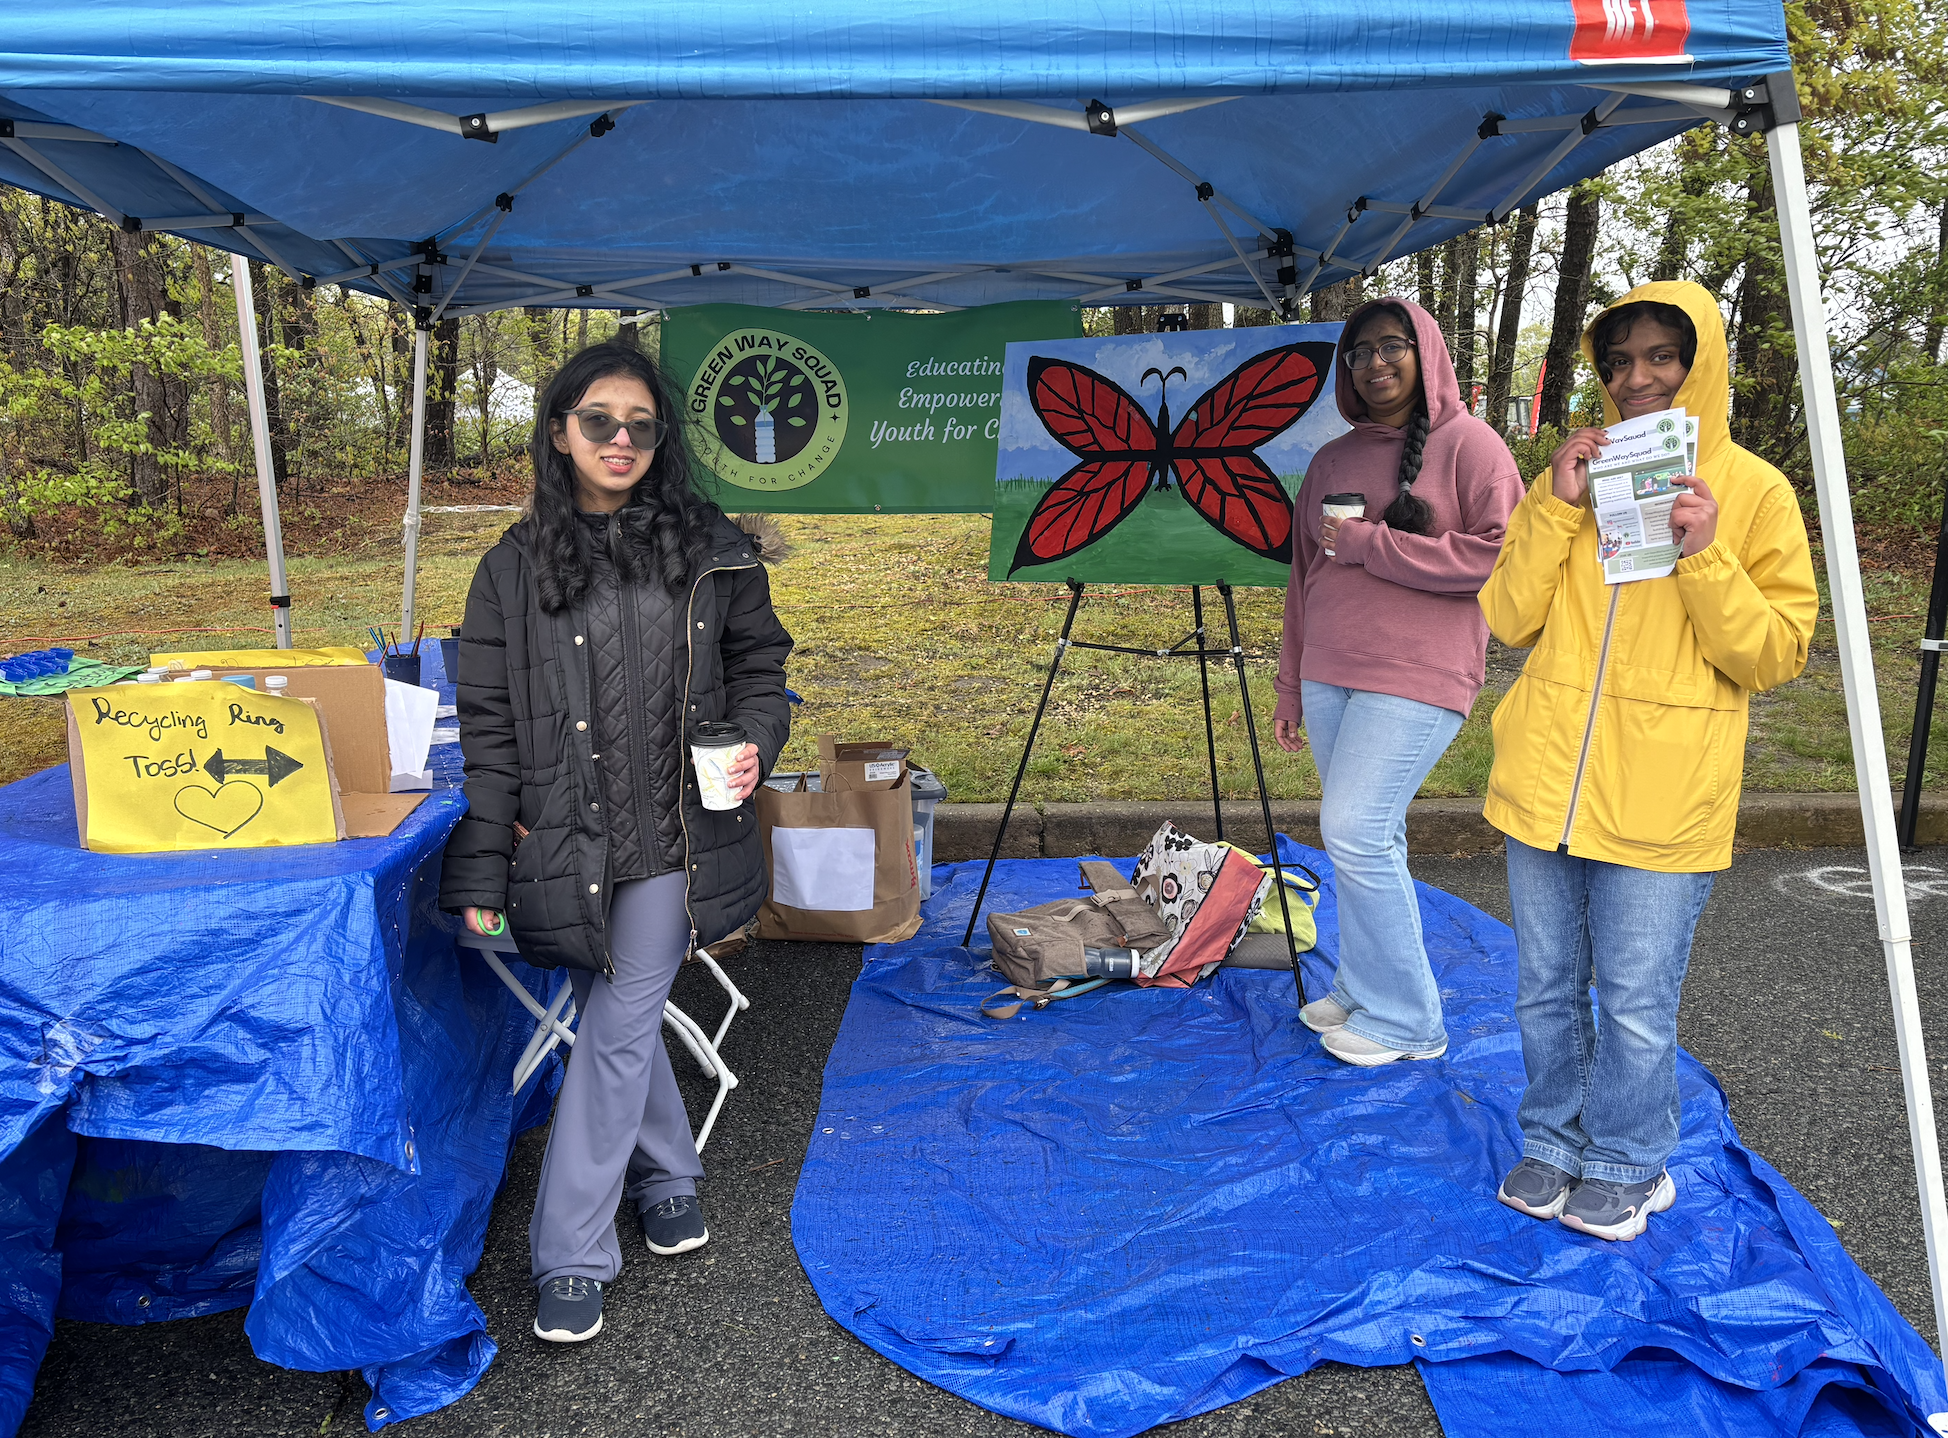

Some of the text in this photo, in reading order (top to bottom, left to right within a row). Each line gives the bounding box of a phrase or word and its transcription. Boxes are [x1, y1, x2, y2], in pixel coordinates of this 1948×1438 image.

[691, 334, 842, 414] GREEN WAY SQUAD
[906, 356, 1005, 378] Educatin
[898, 387, 1003, 415] Empower
[870, 417, 1000, 449] Youth for C
[698, 435, 836, 486] YOUTH FOR CHANGE
[1592, 447, 1652, 466] GreenWaySquad
[91, 696, 285, 741] Recycling Ring
[123, 748, 199, 779] Toss!
